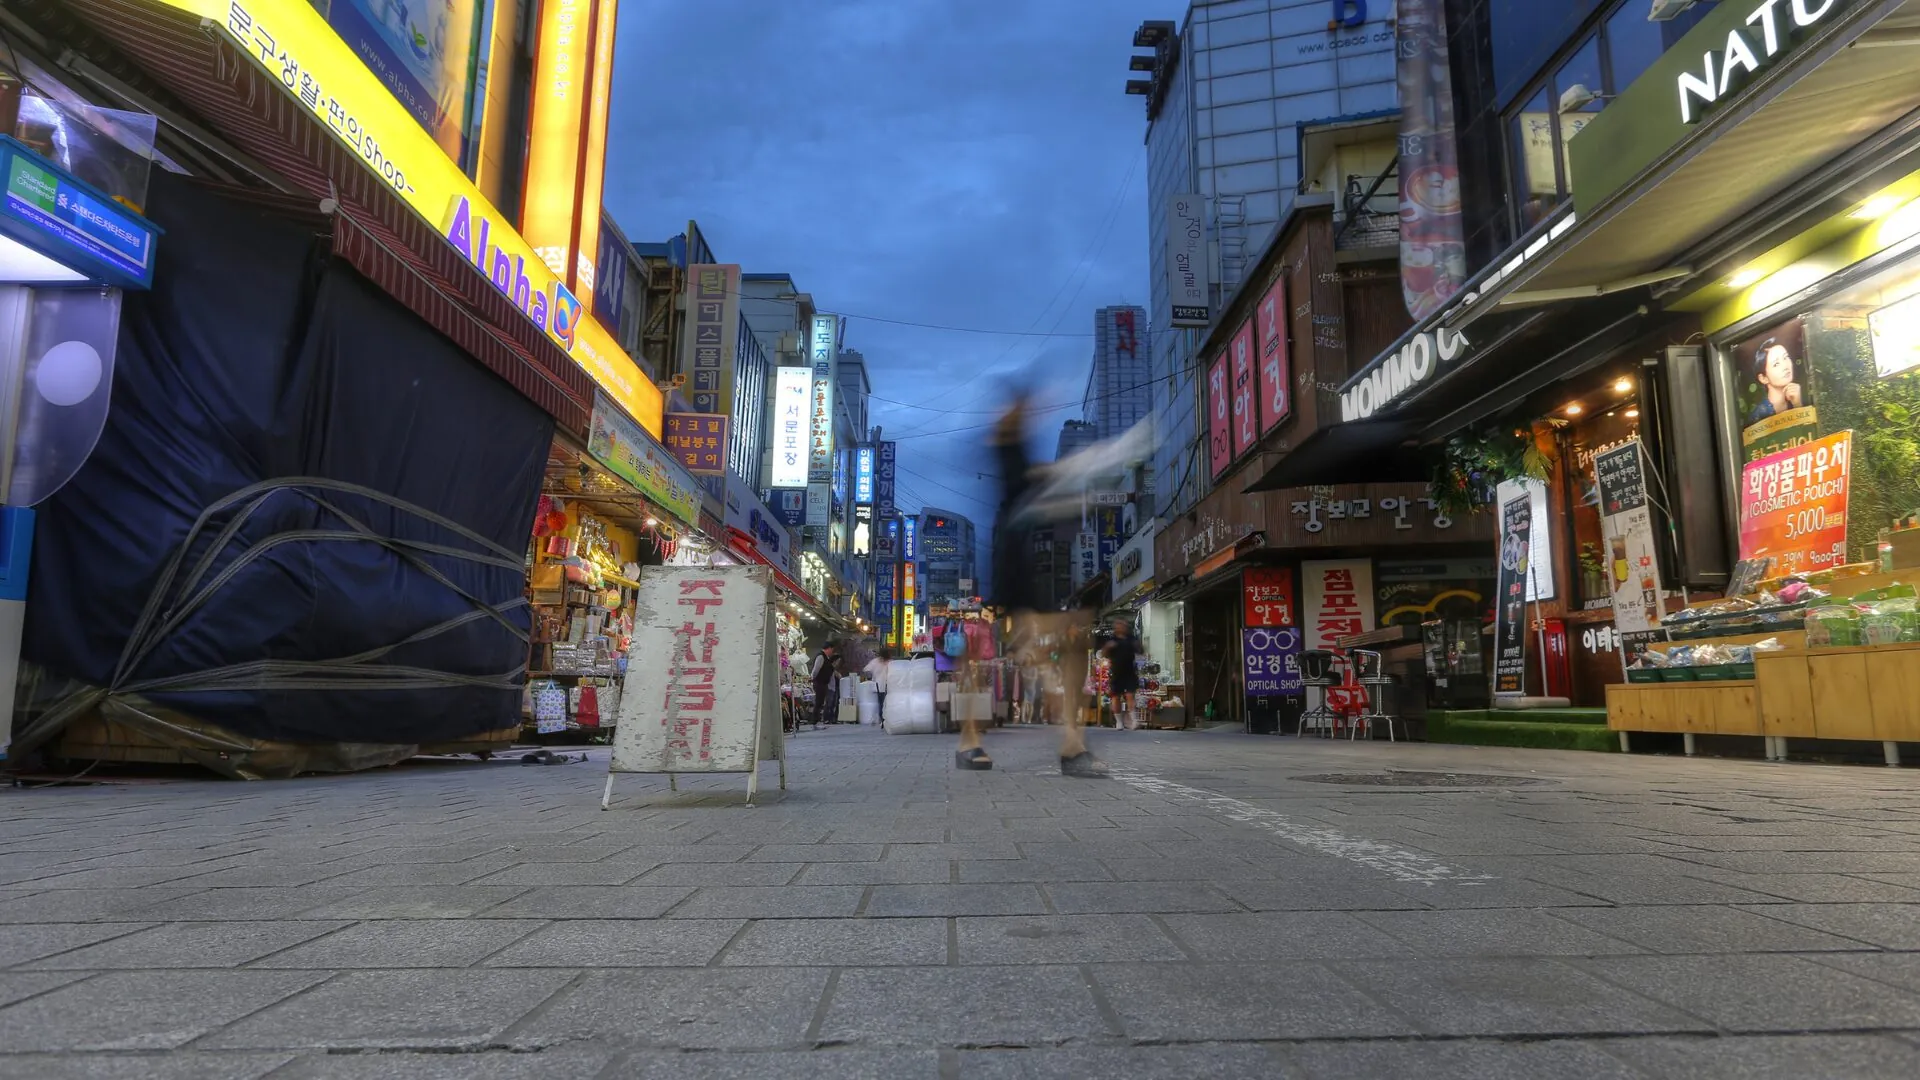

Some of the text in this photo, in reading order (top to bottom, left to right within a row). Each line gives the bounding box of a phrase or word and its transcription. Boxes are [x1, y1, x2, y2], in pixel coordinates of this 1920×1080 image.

[446, 194, 549, 333] Alpha
[1341, 332, 1430, 422] MOMMO
[666, 435, 720, 450] 비닐봉투
[667, 419, 720, 434] 아크릴
[784, 404, 800, 466] 서문포장
[1749, 440, 1848, 500] 화장품파우치
[1291, 496, 1371, 532] 장보고
[1750, 477, 1843, 518] (COSMETIC POUCH)
[1785, 506, 1825, 540] 5,000
[1245, 586, 1280, 602] 장보고
[1254, 604, 1292, 625] 안경
[1246, 654, 1300, 675] 안경원
[1247, 680, 1300, 691] OPTICAL SHOP
